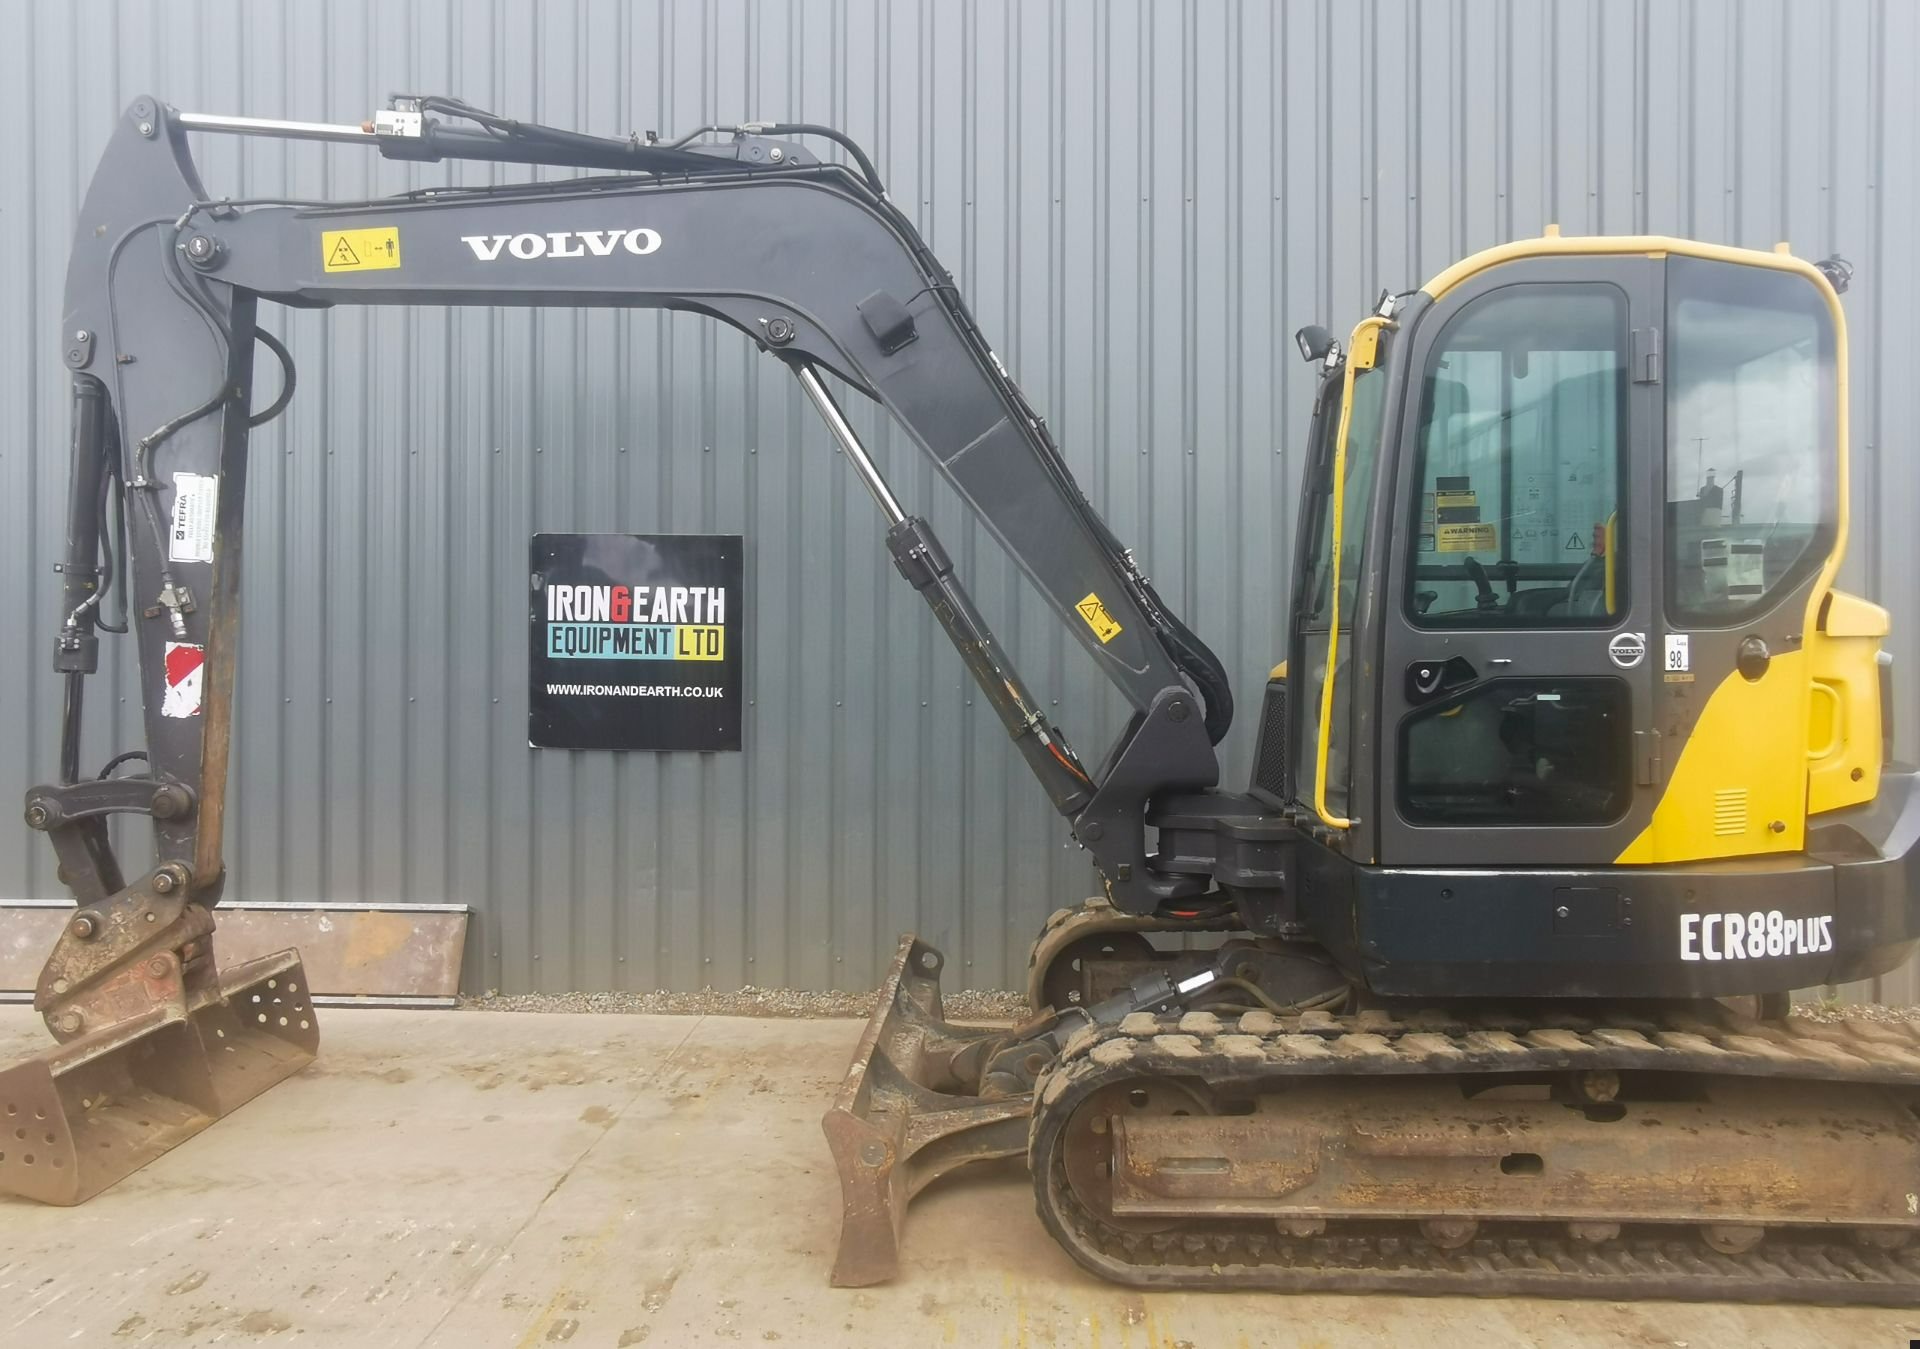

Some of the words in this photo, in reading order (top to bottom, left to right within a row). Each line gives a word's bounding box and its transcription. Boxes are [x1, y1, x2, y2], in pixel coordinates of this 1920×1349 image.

[461, 228, 662, 261] VOLVO
[178, 494, 188, 529] TEFRA
[551, 626, 672, 657] EQUIPMENT
[679, 628, 720, 656] LTD
[1669, 650, 1682, 669] 98
[546, 683, 724, 698] WWW.IRONANDEARTH.CO.UK
